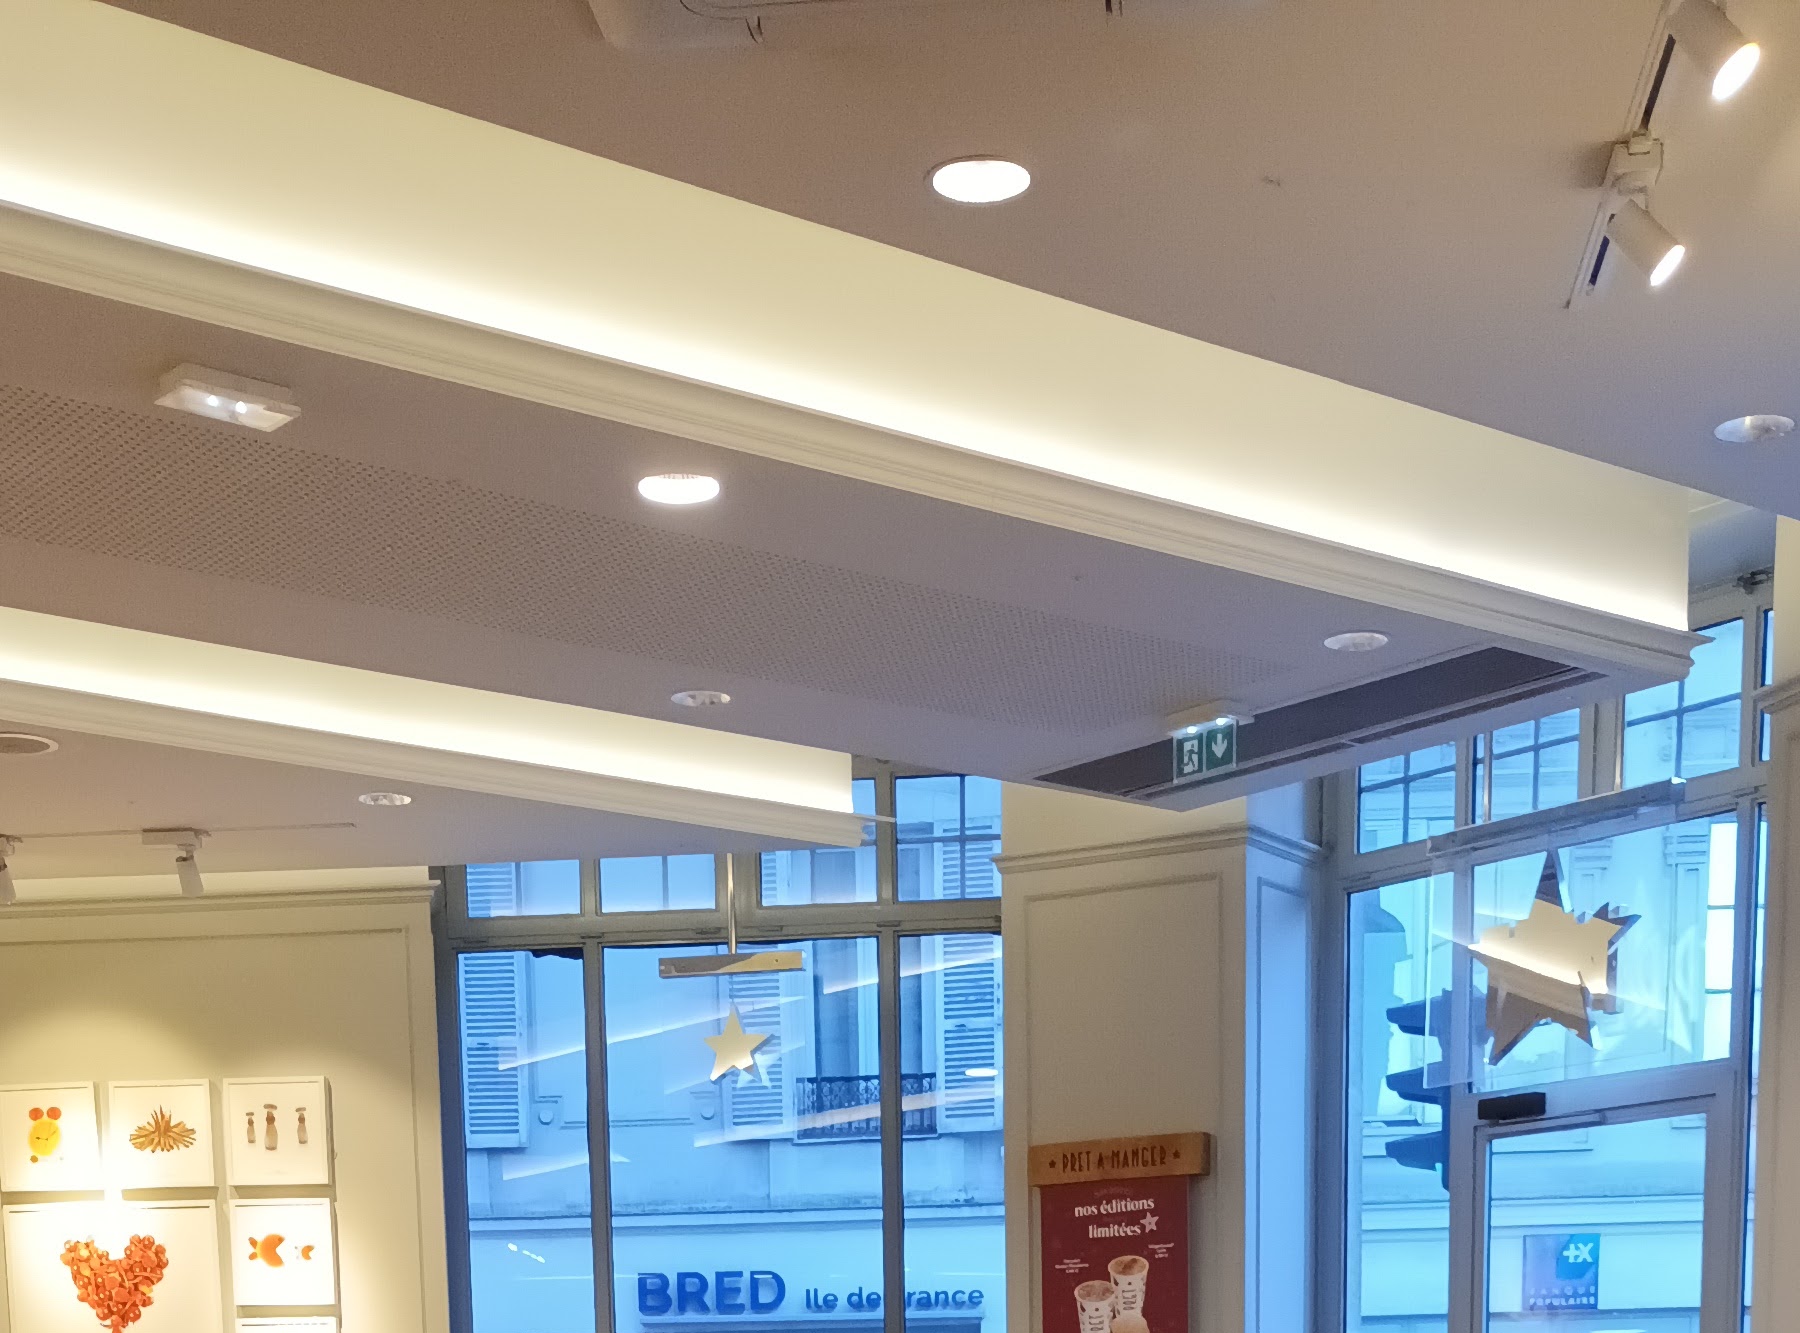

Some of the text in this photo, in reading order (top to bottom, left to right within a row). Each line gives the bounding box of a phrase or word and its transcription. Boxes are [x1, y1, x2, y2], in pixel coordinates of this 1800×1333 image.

[1062, 1151, 1091, 1173] PRET
[1111, 1145, 1167, 1169] MANGER
[1074, 1198, 1155, 1218] nos éditions
[1088, 1222, 1142, 1239] limitées
[637, 1270, 985, 1316] BRED Ile de rance
